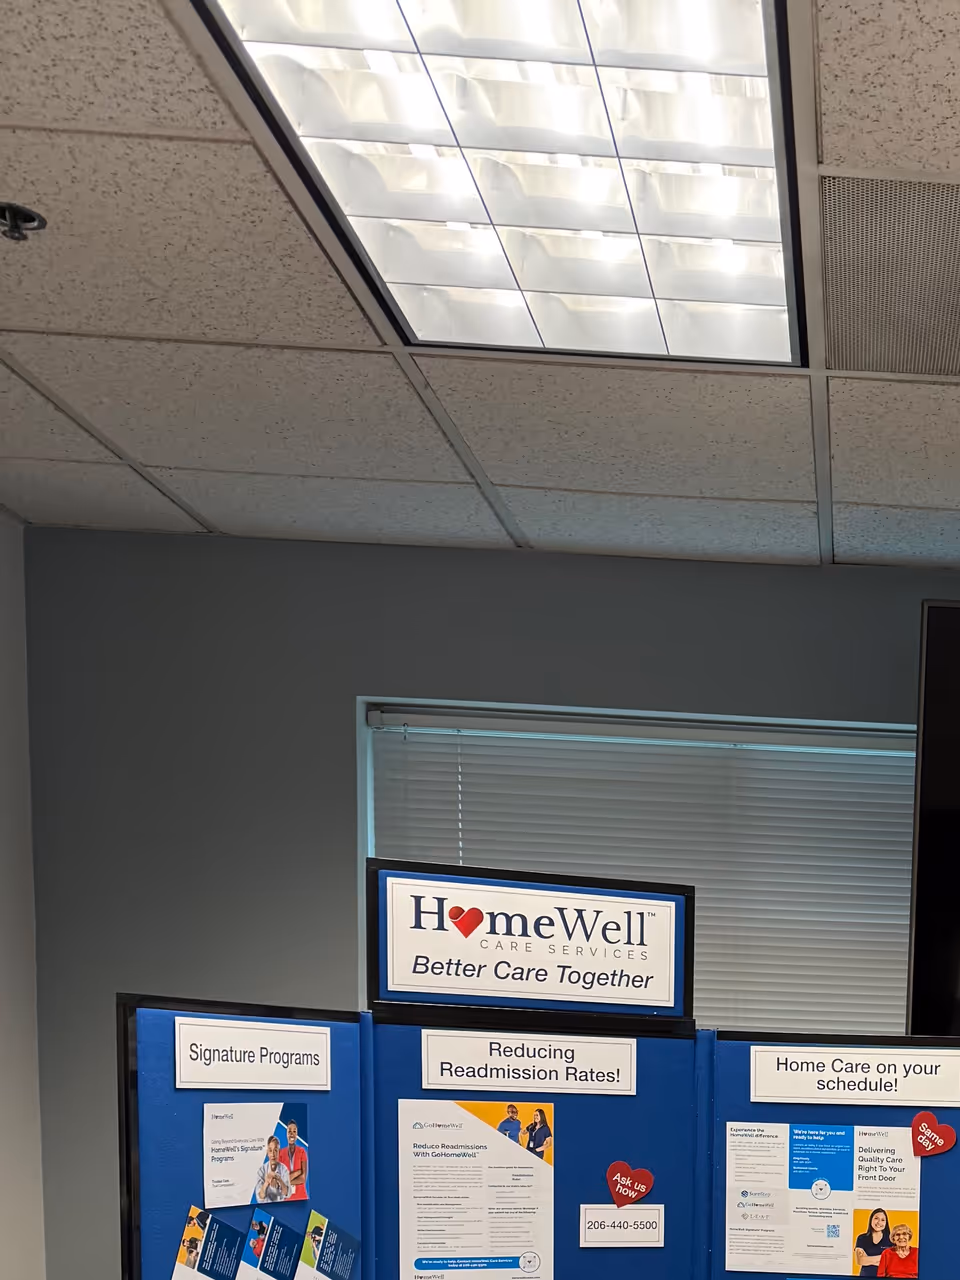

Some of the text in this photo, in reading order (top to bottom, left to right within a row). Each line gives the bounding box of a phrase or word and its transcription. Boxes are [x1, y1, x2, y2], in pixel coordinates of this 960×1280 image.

[480, 939, 648, 961] CARE SERVICES
[412, 955, 654, 990] Better Care Together
[189, 1042, 320, 1069] Signature Programs
[489, 1041, 575, 1064] Reducing
[440, 1062, 620, 1083] Readmission Rates!
[776, 1057, 941, 1078] Home Care on your
[816, 1077, 898, 1092] schedule!
[918, 1122, 944, 1146] Same
[918, 1134, 936, 1151] day
[412, 1142, 440, 1150] Reduce
[858, 1146, 896, 1155] Delivering
[858, 1156, 903, 1164] Quality Care
[858, 1164, 878, 1174] Right
[612, 1172, 647, 1192] Ask us
[858, 1174, 896, 1182] Front Door
[616, 1183, 638, 1198] how
[586, 1220, 658, 1231] 206-440-5500
